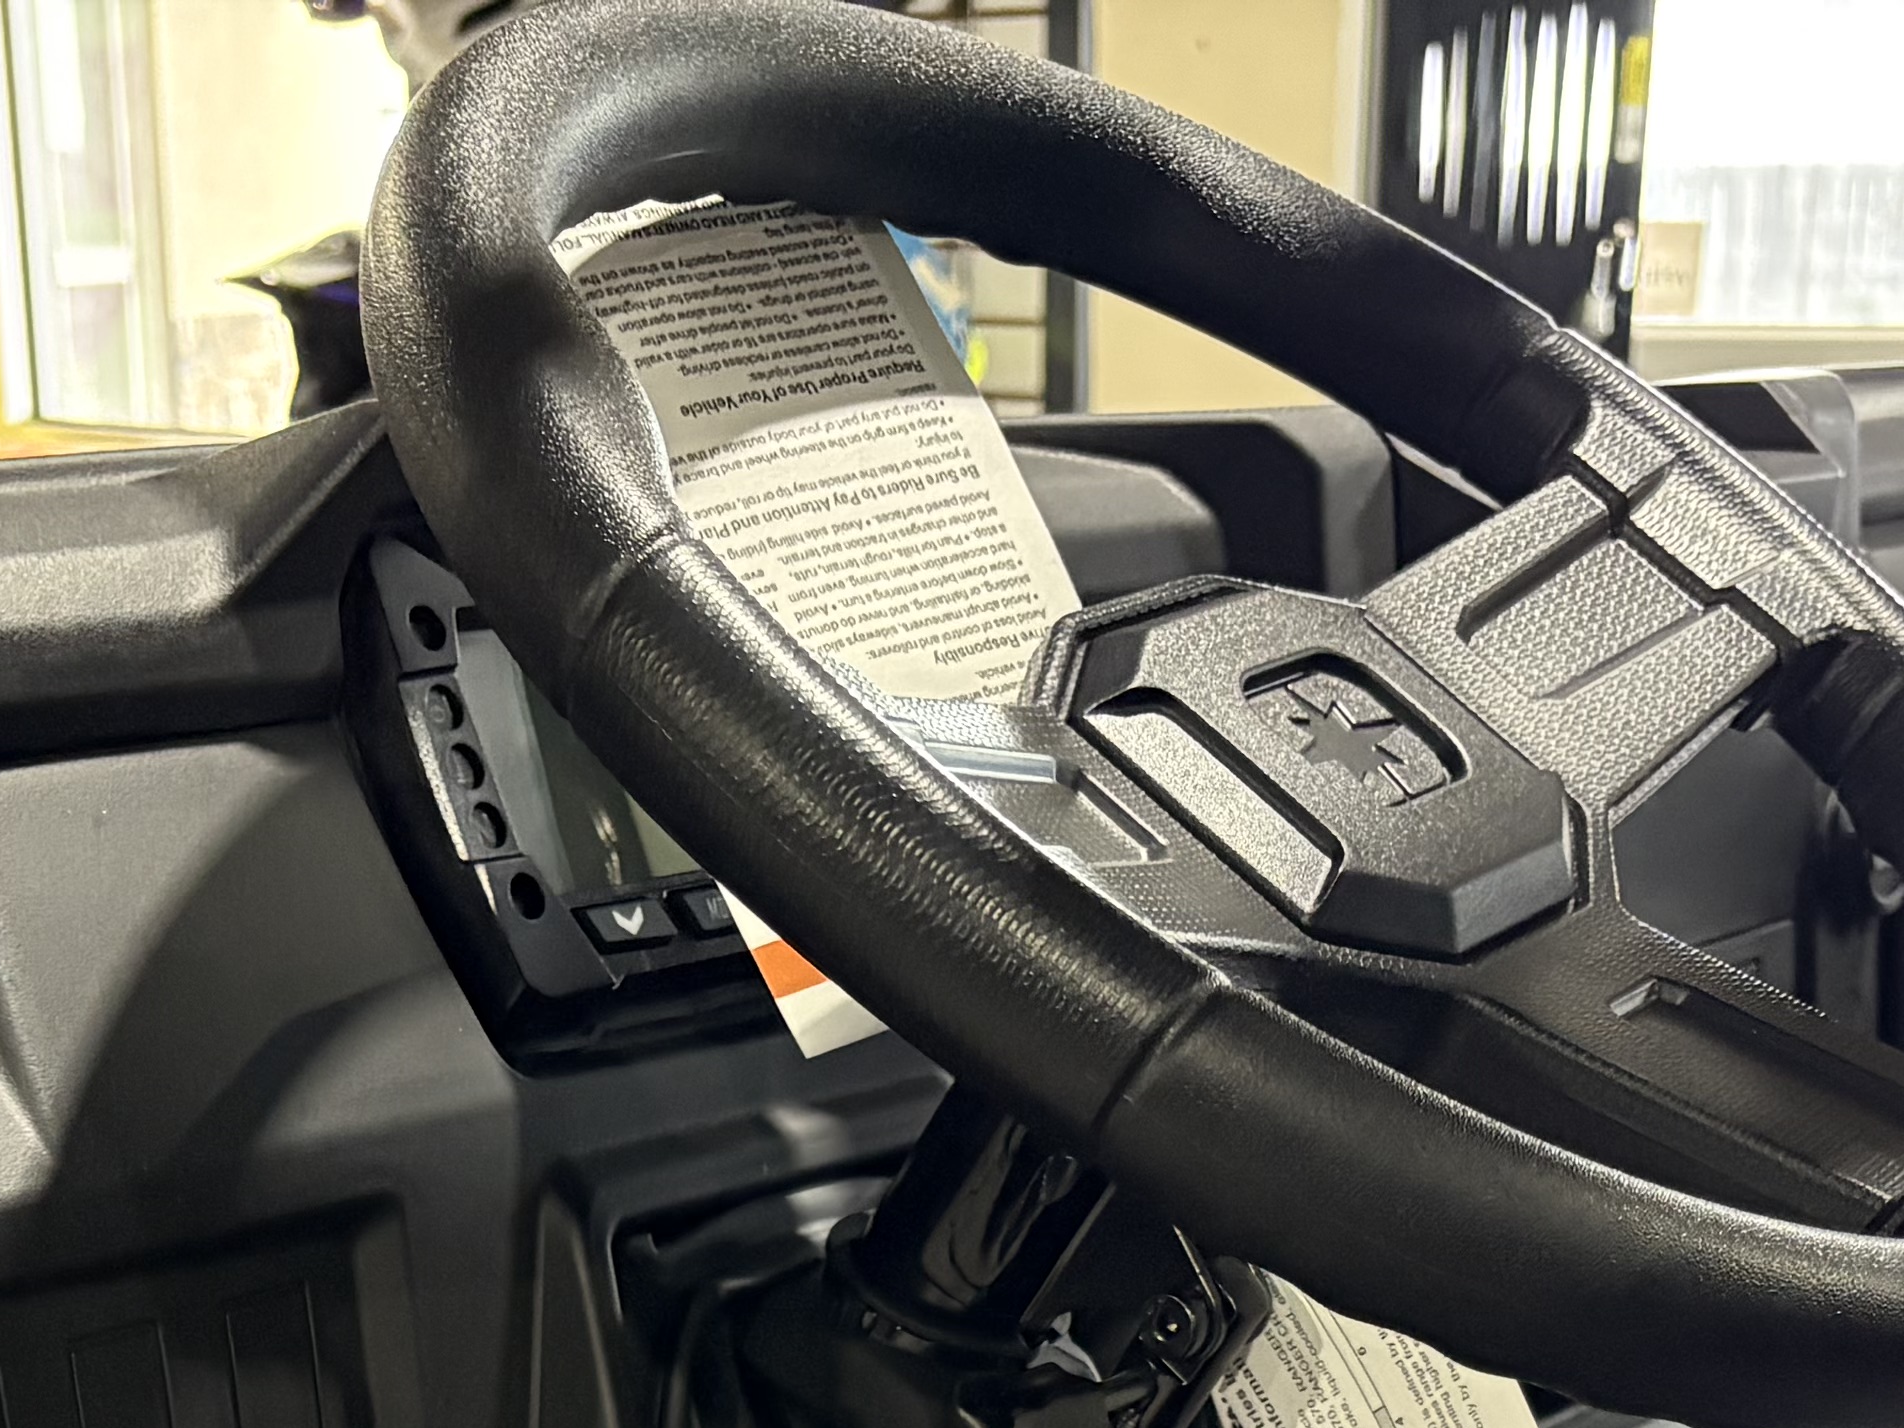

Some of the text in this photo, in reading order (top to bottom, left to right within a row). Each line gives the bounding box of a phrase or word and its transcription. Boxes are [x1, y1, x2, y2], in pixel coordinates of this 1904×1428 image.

[679, 355, 924, 419] Require Proper Use of Your Vehicle
[683, 412, 946, 485] Keep a firm grip on the steering wheel and brace
[939, 446, 961, 461] you
[877, 462, 900, 477] feel
[900, 460, 912, 469] or
[912, 453, 941, 470] think
[817, 471, 858, 490] vehicle
[859, 467, 878, 481] the
[924, 468, 959, 489] Sure
[958, 463, 980, 481] Be
[775, 483, 792, 501] tip
[792, 477, 817, 493] may
[876, 476, 925, 500] Riders
[736, 491, 761, 511] roll,
[762, 491, 774, 501] or
[832, 487, 860, 510] Pay
[860, 487, 877, 504] to
[693, 501, 736, 523] reduce
[762, 497, 830, 527] Attention
[725, 490, 990, 560] Avoid paved surfaces. Avoid side hilling (riding
[730, 514, 761, 535] and
[776, 506, 997, 568] and other changes in traction and terrain.
[989, 540, 1016, 556] hard
[920, 546, 989, 572] acceleration
[845, 566, 889, 589] turning,
[889, 562, 920, 579] when
[787, 587, 817, 604] from
[816, 579, 845, 594] even
[796, 570, 1030, 641] skidding, or fishtailing, and never do donuts
[962, 597, 1000, 619] abrupt
[897, 606, 963, 632] maneuvers,
[993, 615, 1017, 631] loss
[1016, 608, 1046, 625] Avoid
[844, 622, 898, 649] sideways
[918, 634, 939, 648] and
[941, 624, 980, 643] control
[932, 629, 1019, 667] Responsibly
[1262, 1328, 1307, 1392] RANGER
[1443, 1360, 1460, 1382] the
[1455, 1383, 1472, 1401] by
[1394, 1416, 1405, 1426] 4
